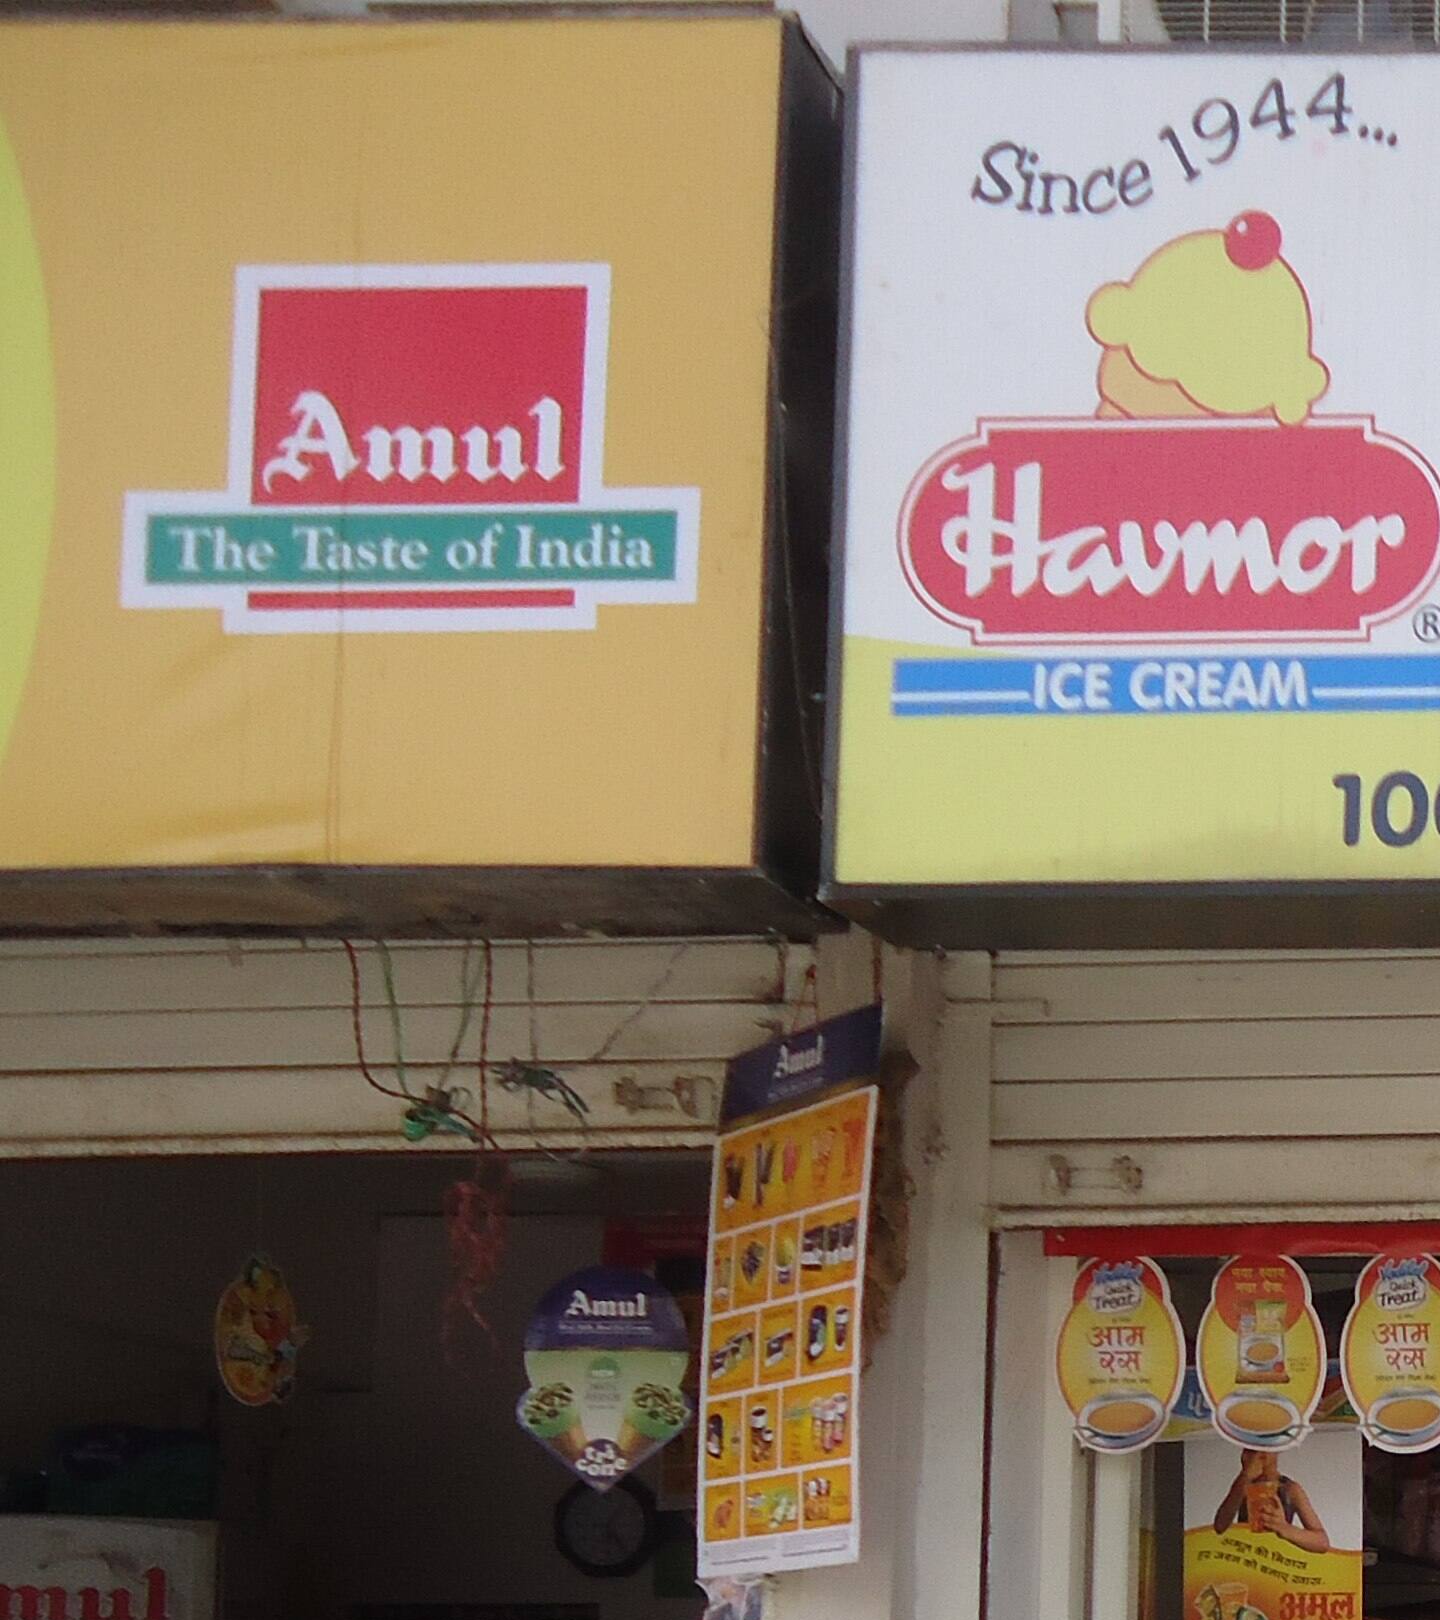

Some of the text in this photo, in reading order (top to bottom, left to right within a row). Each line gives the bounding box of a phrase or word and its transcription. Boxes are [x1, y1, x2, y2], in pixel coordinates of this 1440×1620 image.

[971, 72, 1398, 215] Since 1944...
[262, 390, 566, 496] Amul
[940, 460, 1405, 598] Havmor
[169, 524, 654, 571] The Taste of India
[1033, 661, 1308, 709] ICE CREAM
[565, 1290, 647, 1316] Amul
[1087, 1326, 1146, 1347] आम
[1372, 1323, 1431, 1344] आम
[1099, 1351, 1142, 1373] रस
[1384, 1348, 1426, 1370] रस
